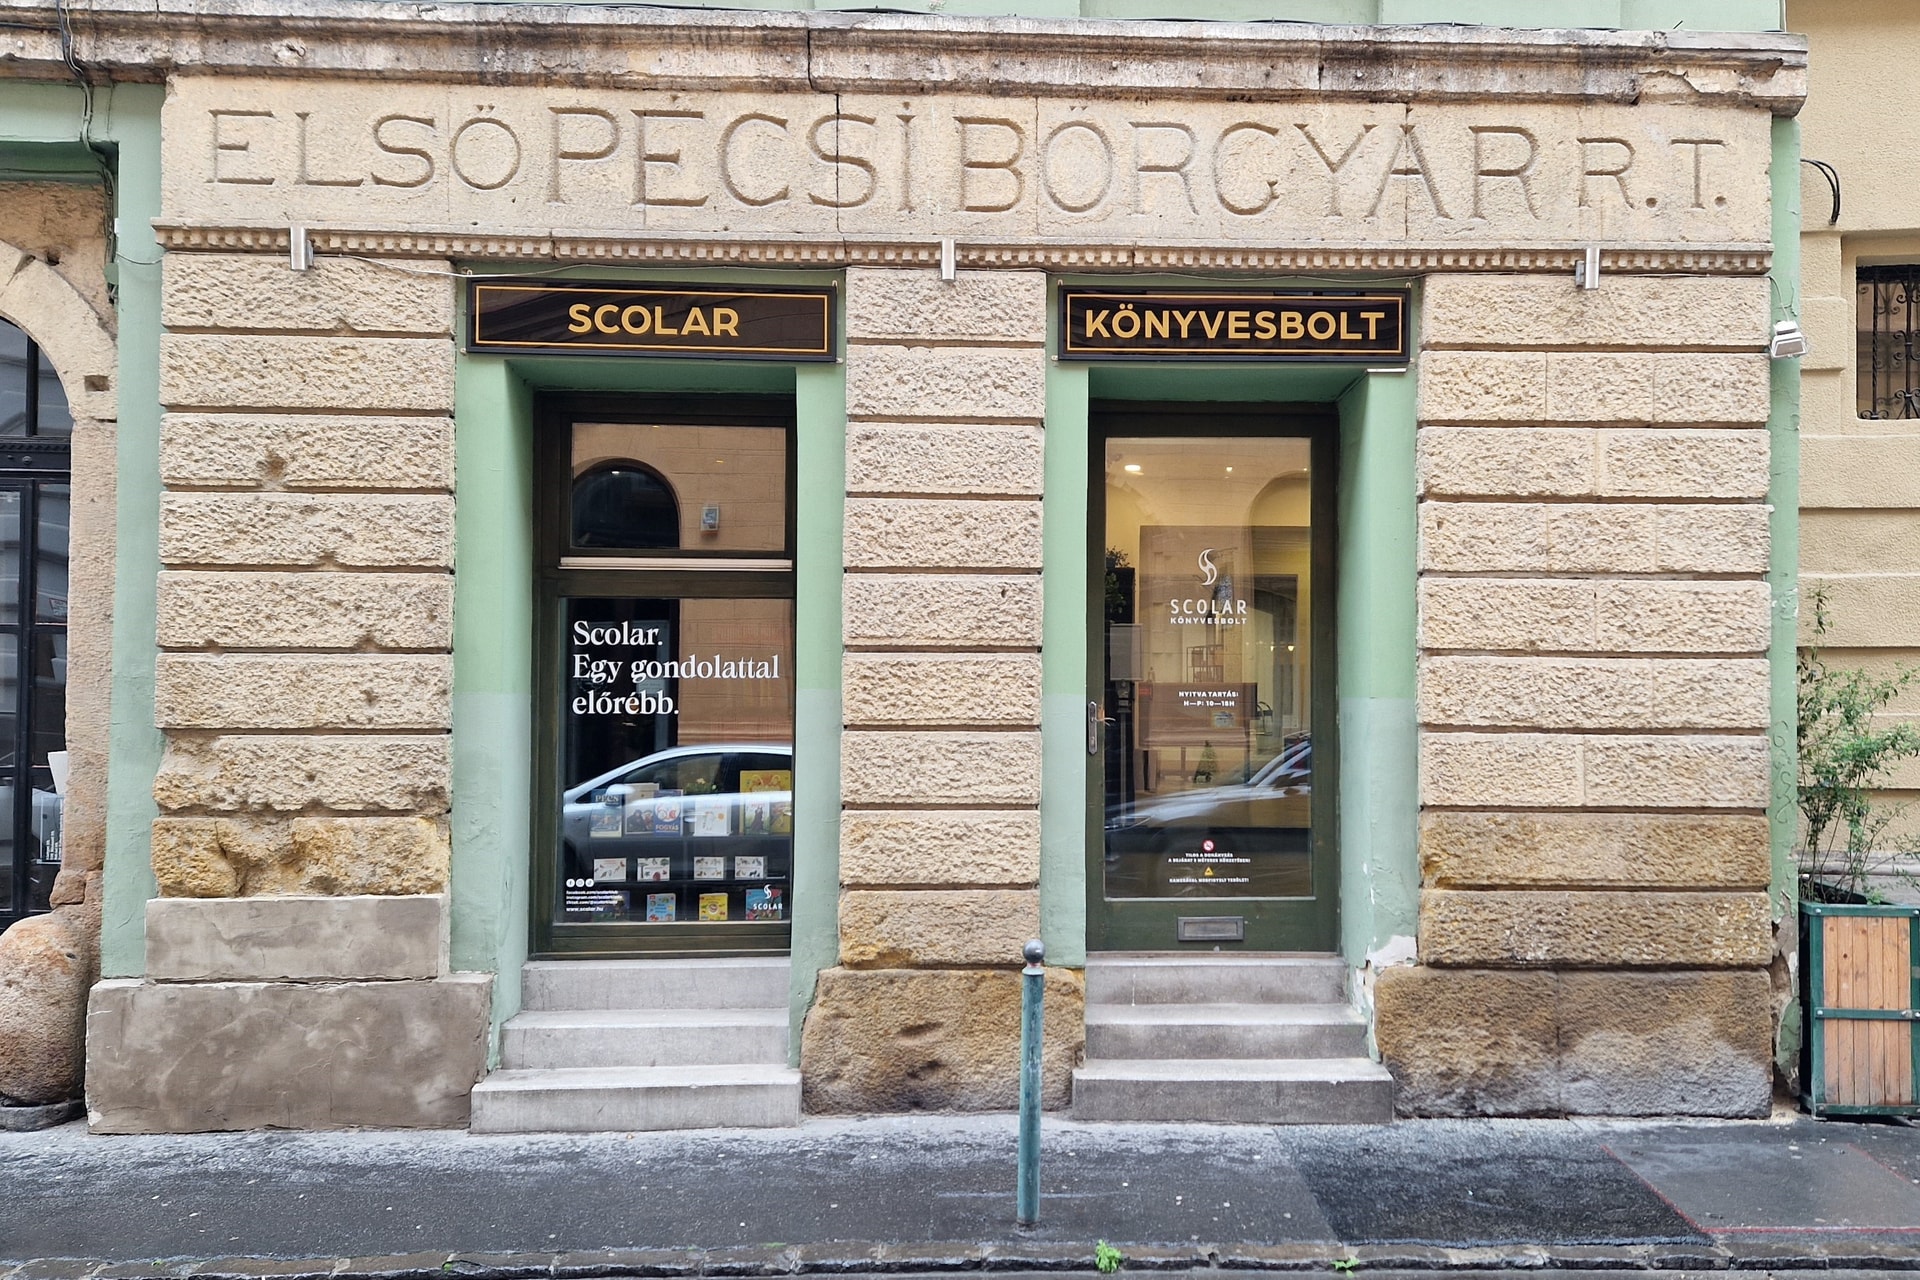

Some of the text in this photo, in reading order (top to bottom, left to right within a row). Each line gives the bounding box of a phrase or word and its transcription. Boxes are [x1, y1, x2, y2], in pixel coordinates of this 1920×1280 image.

[567, 303, 740, 338] SCOLAR
[1085, 303, 1386, 342] KÖNYVESBOLT
[1170, 599, 1247, 614] SCOLAR
[573, 620, 663, 646] Scolar.
[1170, 616, 1247, 624] KÖNYVESBOLT
[573, 653, 780, 684] Egy gondolattal
[572, 689, 680, 715] előrébb.
[1208, 690, 1239, 698] TARTÁS:
